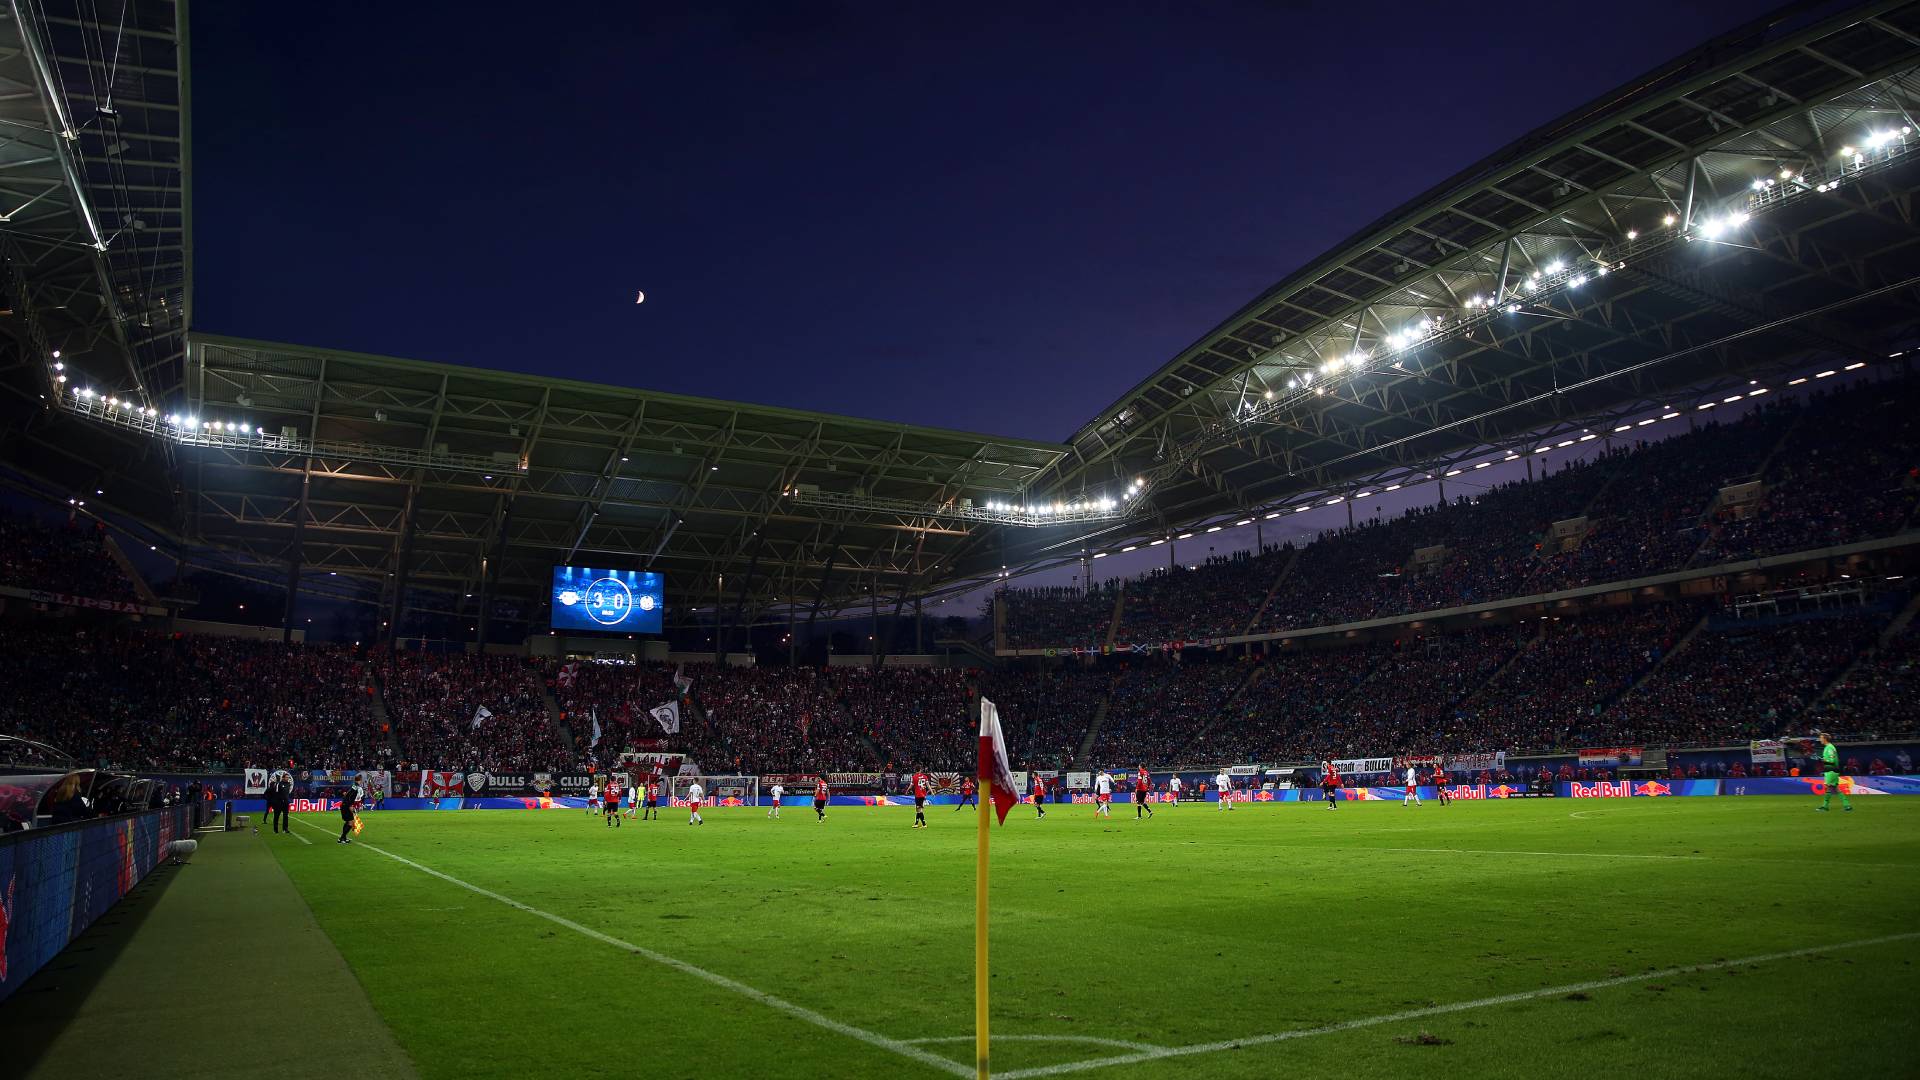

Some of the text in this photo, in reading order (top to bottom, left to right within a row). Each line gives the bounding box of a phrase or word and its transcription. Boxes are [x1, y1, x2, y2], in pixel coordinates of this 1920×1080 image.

[593, 592, 624, 609] 3 0
[1365, 758, 1391, 772] BULLEN
[489, 776, 590, 786] BULLS CLUB
